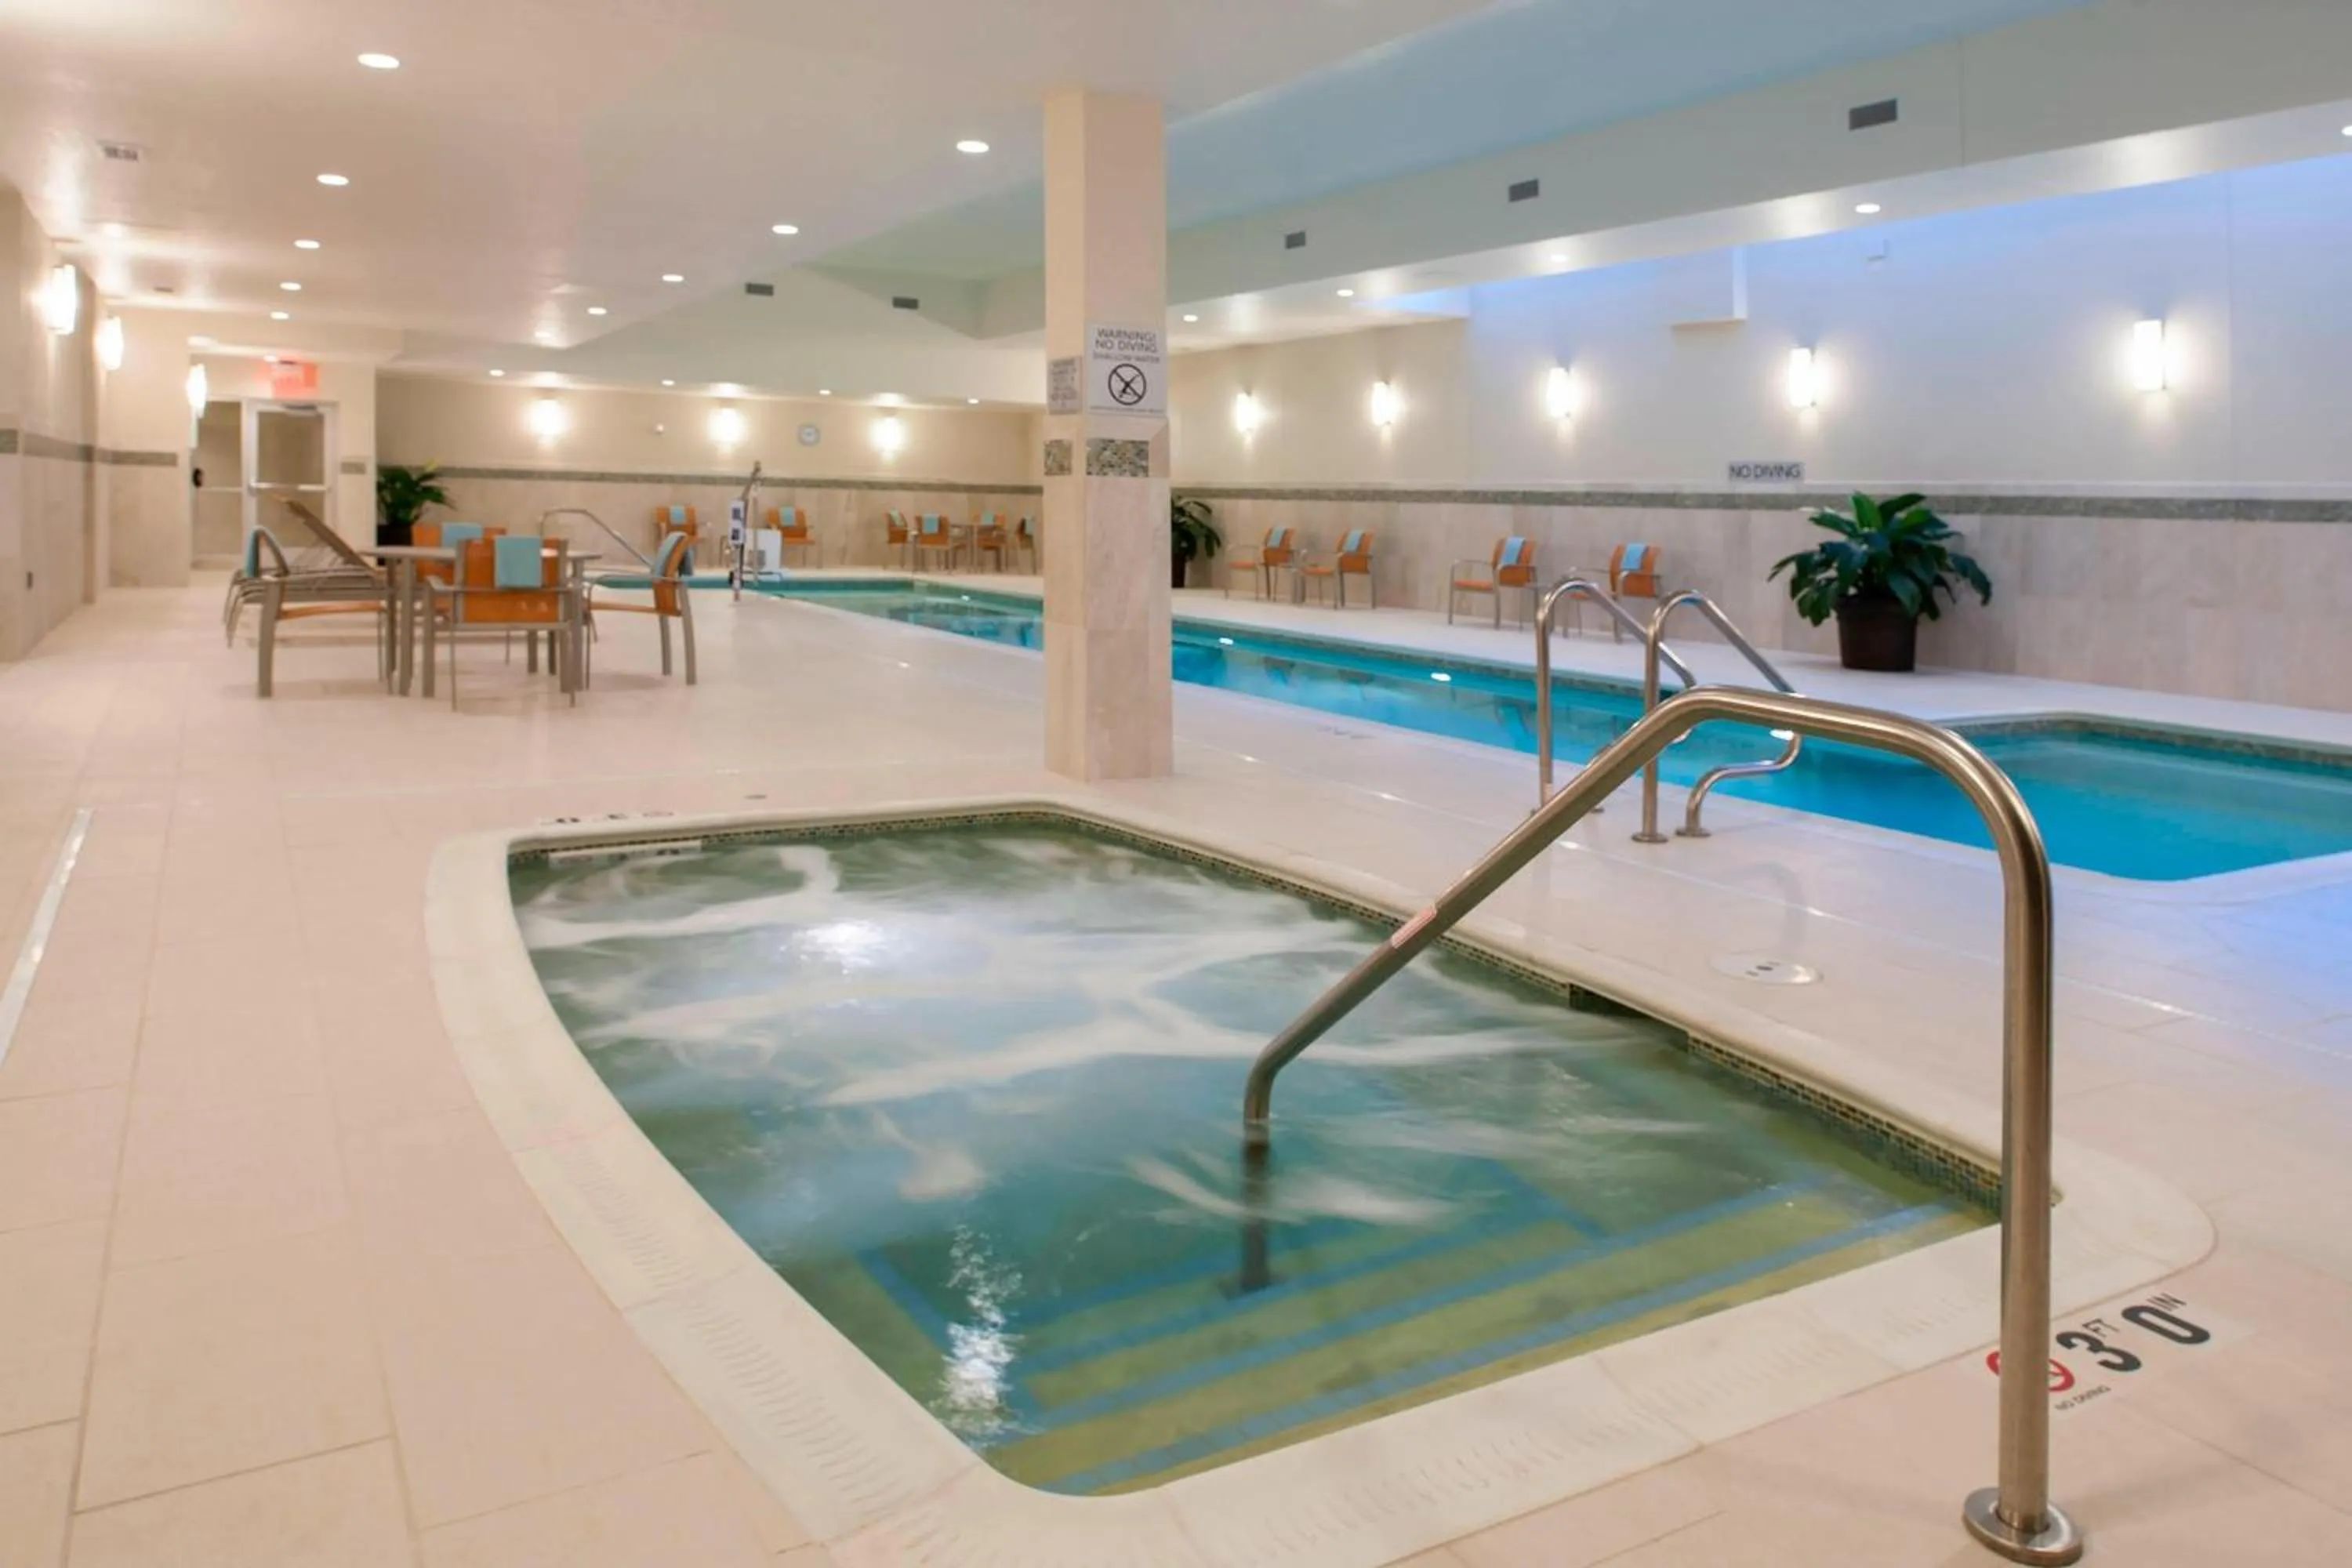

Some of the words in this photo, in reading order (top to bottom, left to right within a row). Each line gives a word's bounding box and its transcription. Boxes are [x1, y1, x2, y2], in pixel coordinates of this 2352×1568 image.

[1097, 328, 1156, 342] WARNING!
[1095, 339, 1114, 350] NO
[1117, 340, 1158, 353] DIVING
[1134, 355, 1160, 364] WATER
[1730, 464, 1751, 478] NO
[1753, 464, 1801, 479] DIVING
[2082, 1318, 2120, 1339] FT
[2121, 1305, 2211, 1345] 0
[2056, 1331, 2142, 1372] 3
[2054, 1400, 2074, 1410] NO
[2073, 1385, 2112, 1404] DIVING
